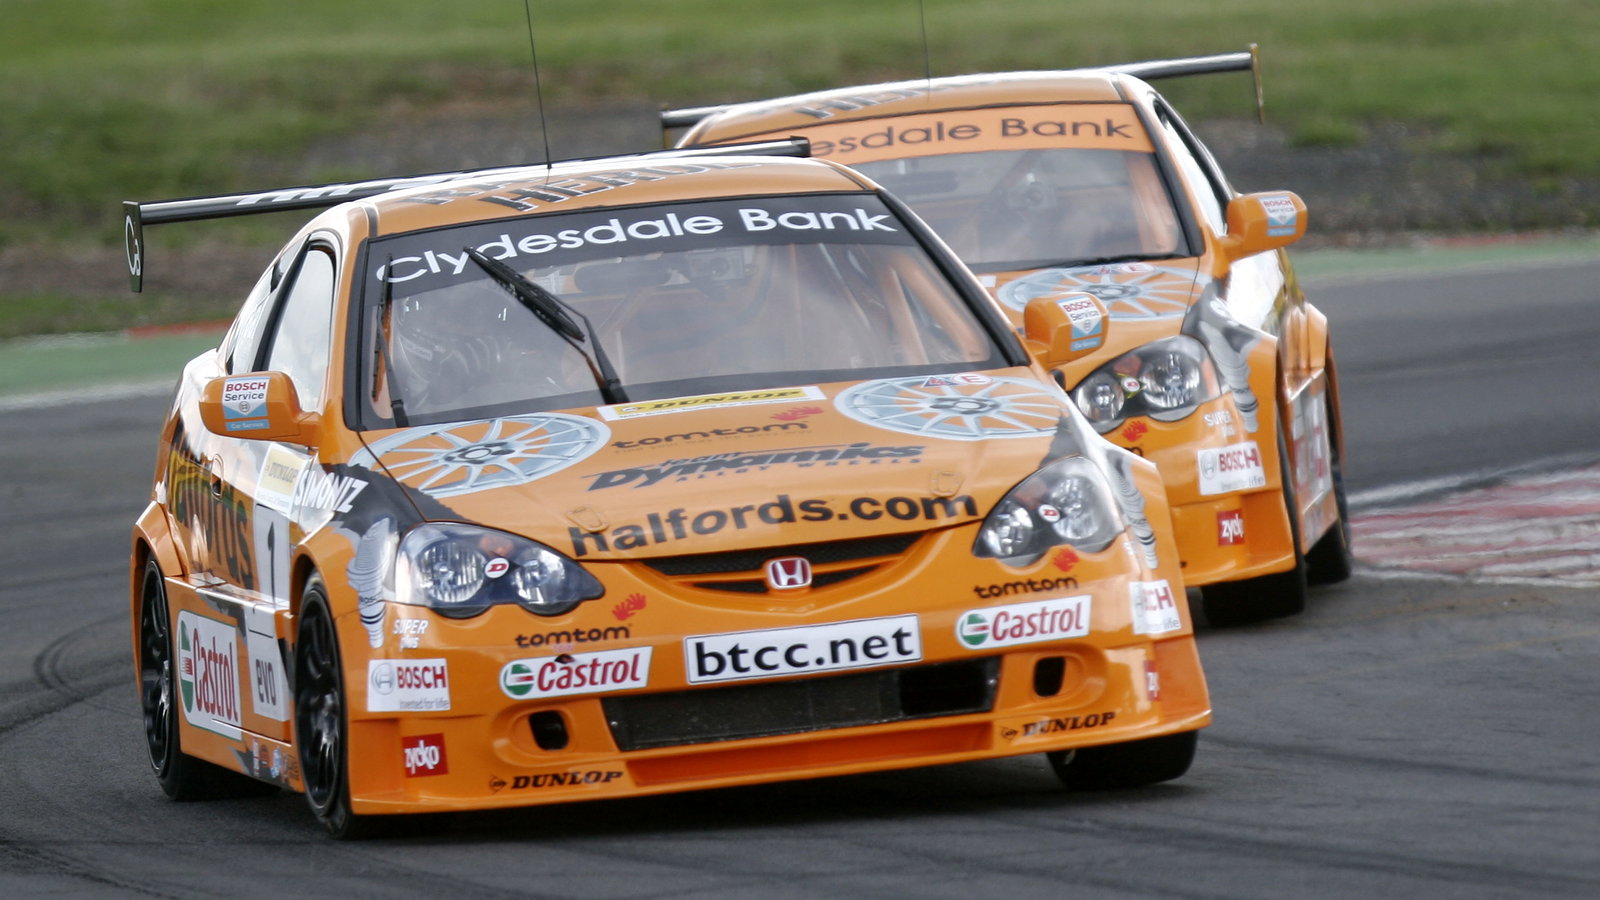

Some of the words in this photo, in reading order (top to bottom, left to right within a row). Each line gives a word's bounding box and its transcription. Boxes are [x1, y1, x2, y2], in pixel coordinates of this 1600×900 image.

[810, 121, 981, 156] esdale
[1001, 117, 1136, 139] Bank
[376, 213, 723, 284] Clydesdale
[738, 207, 898, 233] Bank
[1063, 301, 1093, 312] BOSCH
[1071, 310, 1100, 321] Service
[224, 392, 265, 402] Service
[225, 382, 267, 392] BOSCH
[651, 389, 801, 410] DUNLOP
[612, 421, 808, 448] tomtom
[582, 442, 927, 491] Dynamics
[1218, 448, 1260, 473] BOSCH
[294, 470, 369, 513] SIMONIZ
[567, 494, 979, 557] halfords.com
[267, 520, 276, 607] 1
[974, 577, 1078, 599] tomtom
[393, 619, 429, 635] SUPER
[992, 602, 1084, 641] Castrol
[515, 626, 630, 648] tomtom
[695, 627, 914, 677] btcc.net
[193, 628, 239, 723] Castrol
[255, 659, 277, 706] evo
[397, 666, 446, 688] BOSCH
[537, 654, 640, 692] Castrol
[1023, 712, 1116, 736] DUNLOP
[511, 770, 623, 790] DUNLOP
